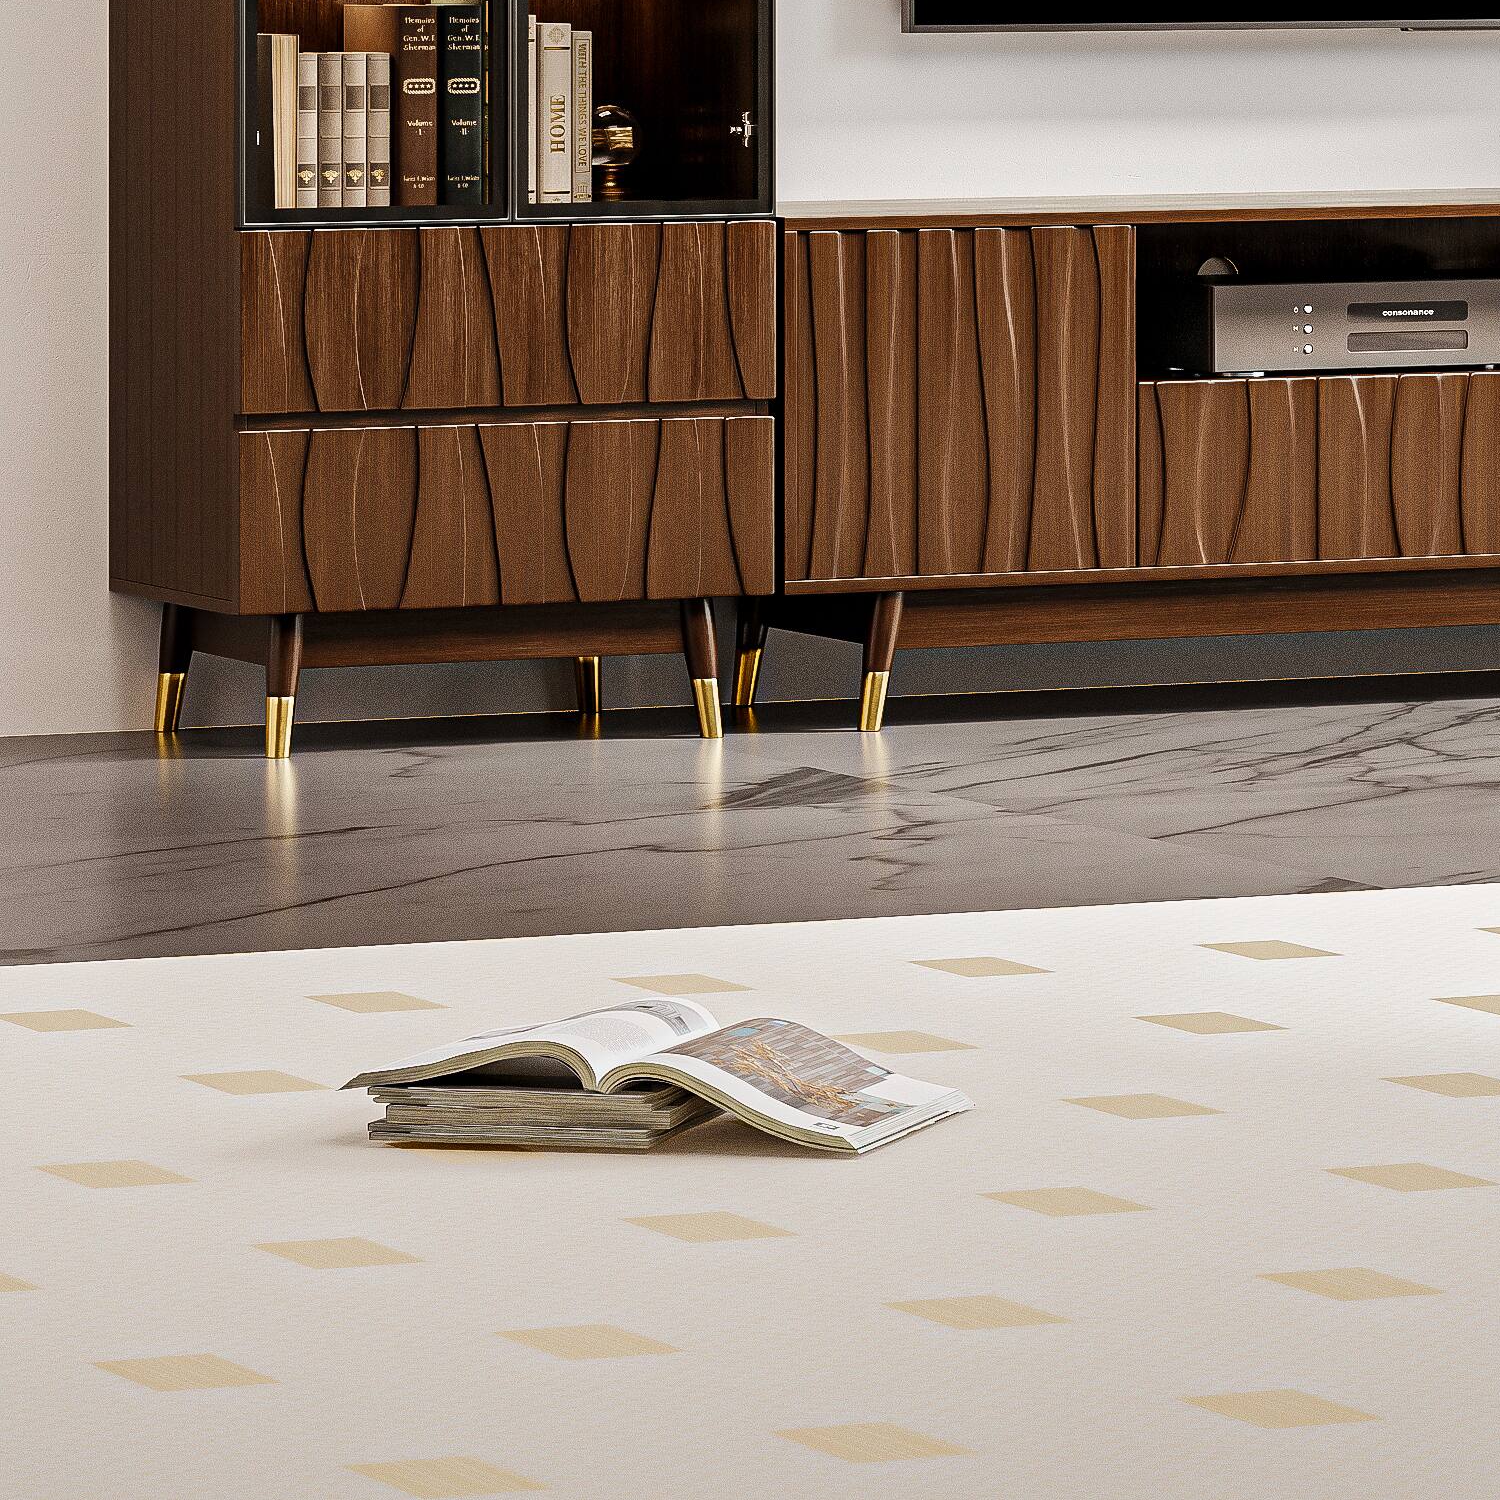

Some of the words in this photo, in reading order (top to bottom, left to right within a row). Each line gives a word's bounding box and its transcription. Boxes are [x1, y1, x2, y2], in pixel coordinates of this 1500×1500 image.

[578, 43, 587, 70] WITH
[578, 71, 587, 89] THE
[578, 90, 587, 125] THINGS
[407, 119, 433, 127] Volume
[451, 118, 477, 126] Volume
[549, 94, 566, 154] HOME
[578, 126, 587, 142] WE
[578, 143, 587, 167] LOVE
[1382, 308, 1435, 317] consonance
